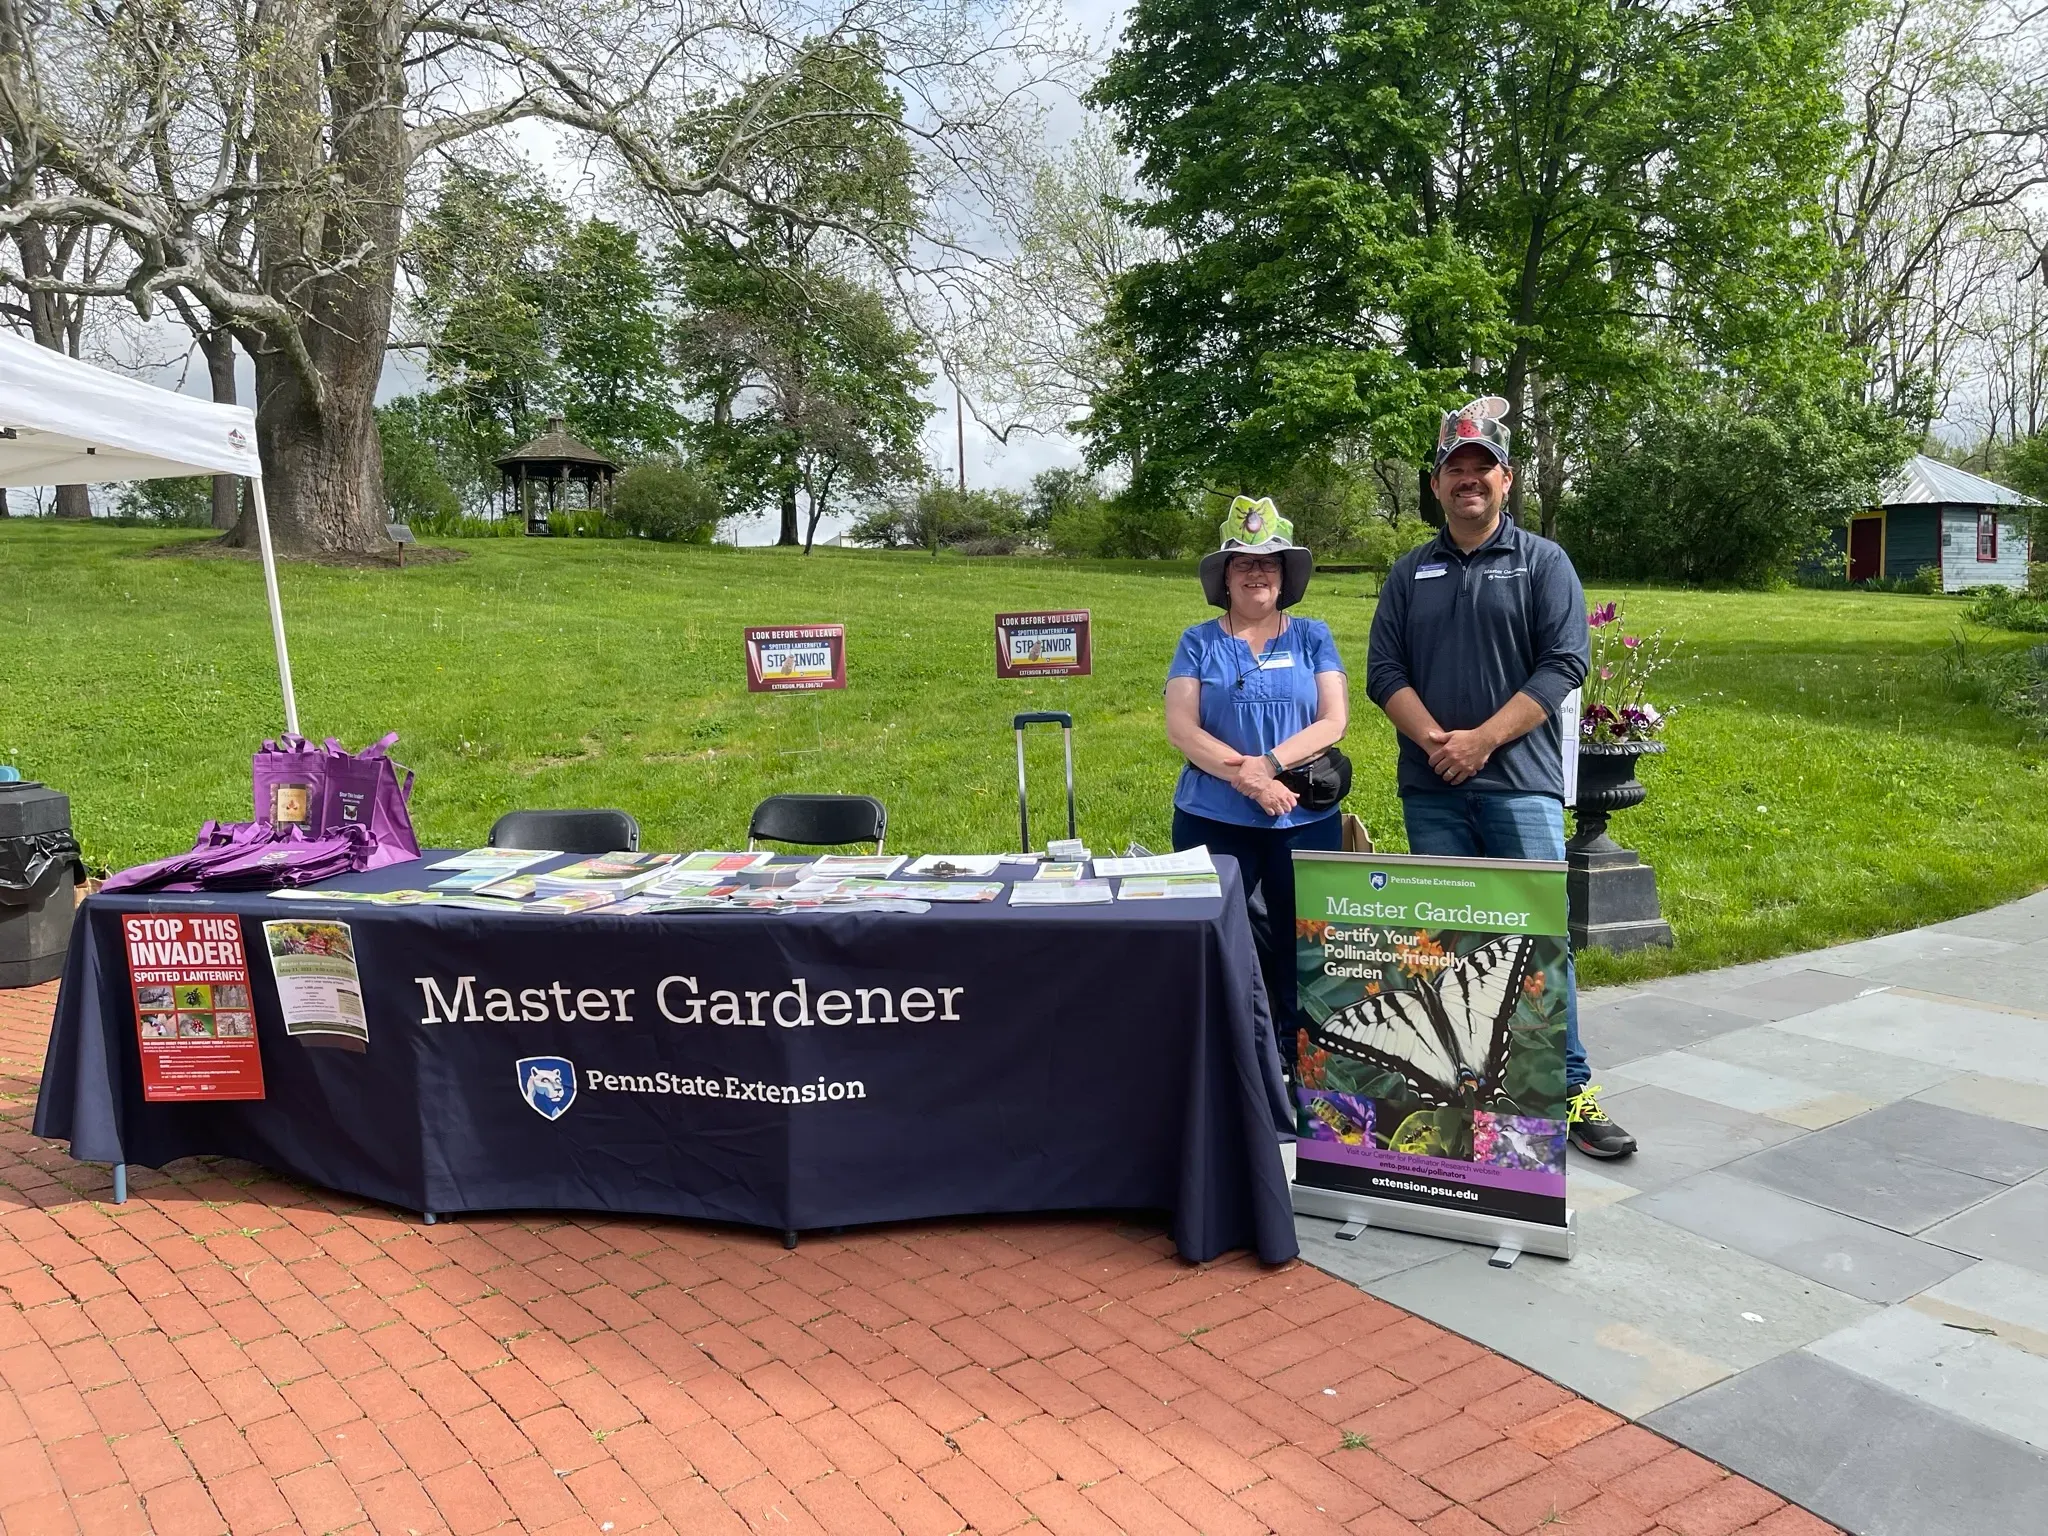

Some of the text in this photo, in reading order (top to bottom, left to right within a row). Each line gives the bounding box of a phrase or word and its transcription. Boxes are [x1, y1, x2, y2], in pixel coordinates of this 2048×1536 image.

[1002, 614, 1082, 626] LOOK BEFORE YOU LEAVE
[752, 628, 837, 640] LOOK BEFORE YOU LEAVE
[1041, 638, 1071, 652] INVDR
[795, 652, 825, 666] INVDR
[1390, 876, 1476, 888] PennState Extension
[1326, 896, 1530, 926] Master Gardener
[126, 919, 239, 941] STOP THIS
[1324, 925, 1420, 947] Certify Your
[130, 942, 243, 966] INVADER!
[1324, 944, 1464, 972] Pollinator-friendly
[134, 971, 245, 983] SPOTTED LANTERNFLY
[1323, 962, 1382, 980] Garden
[414, 976, 635, 1025] Master
[656, 975, 964, 1027] Gardener
[586, 1070, 866, 1104] PennState Extension
[1346, 1147, 1360, 1155] Visit
[1373, 1151, 1395, 1160] Center
[1397, 1154, 1406, 1162] for
[1408, 1155, 1439, 1167] Pollinator
[1441, 1160, 1472, 1172] Research
[1379, 1162, 1466, 1180] ento.psu.edu/pollinators
[1372, 1176, 1479, 1201] extension.psu.edu
